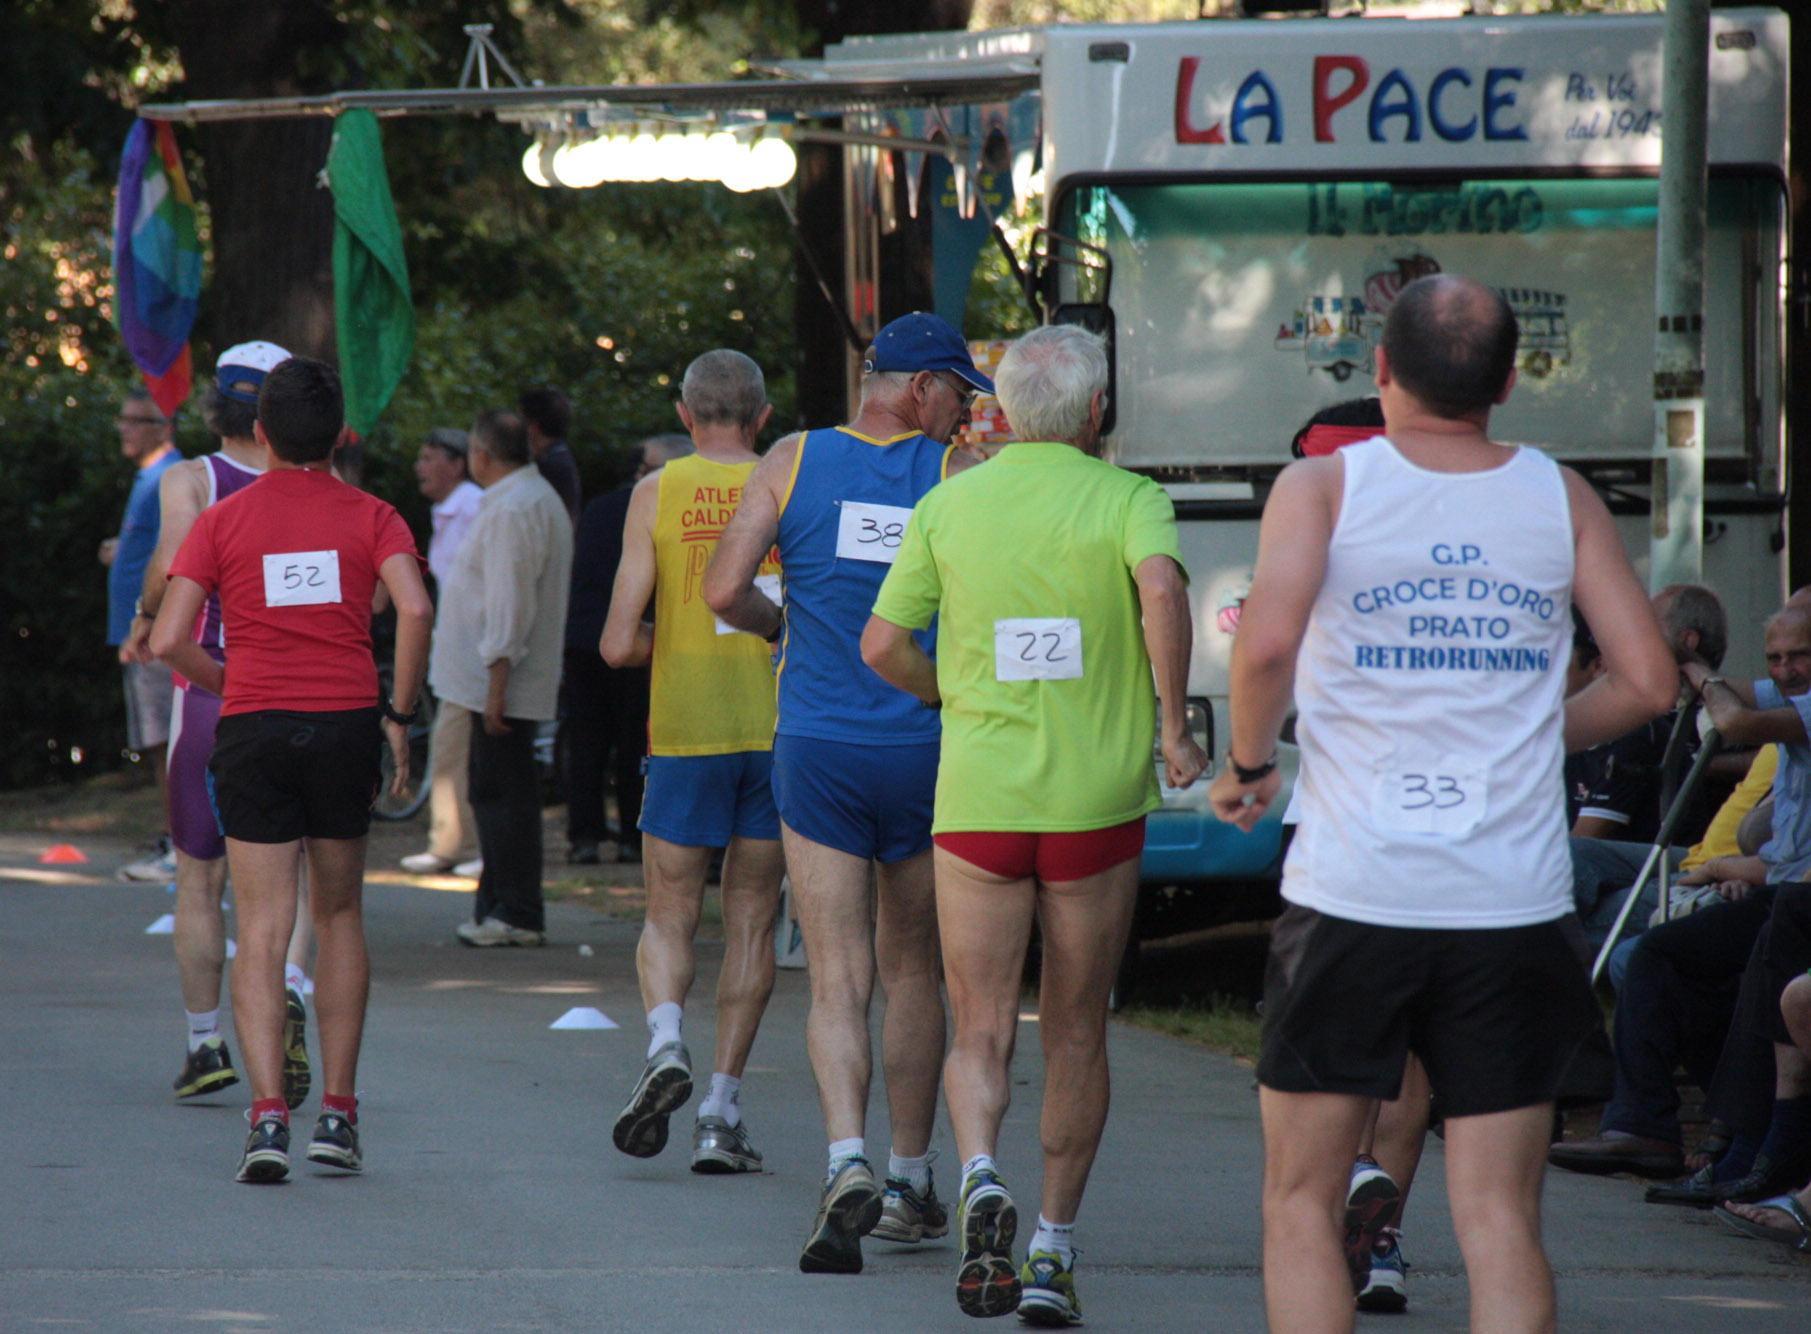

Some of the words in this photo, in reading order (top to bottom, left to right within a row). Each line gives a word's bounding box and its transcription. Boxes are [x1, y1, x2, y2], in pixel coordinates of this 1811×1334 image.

[1174, 55, 1283, 144] LA
[1312, 54, 1529, 143] PACE
[694, 487, 743, 504] ATLE
[856, 518, 904, 548] 38
[1431, 544, 1489, 566] G.P.
[283, 564, 326, 590] 52
[1353, 578, 1456, 614] CROCE
[1467, 578, 1554, 620] D'ORO
[1409, 615, 1511, 639] PRATO
[1016, 631, 1068, 662] 22
[1354, 645, 1551, 672] RETRORUNNING
[1401, 774, 1466, 811] 33
